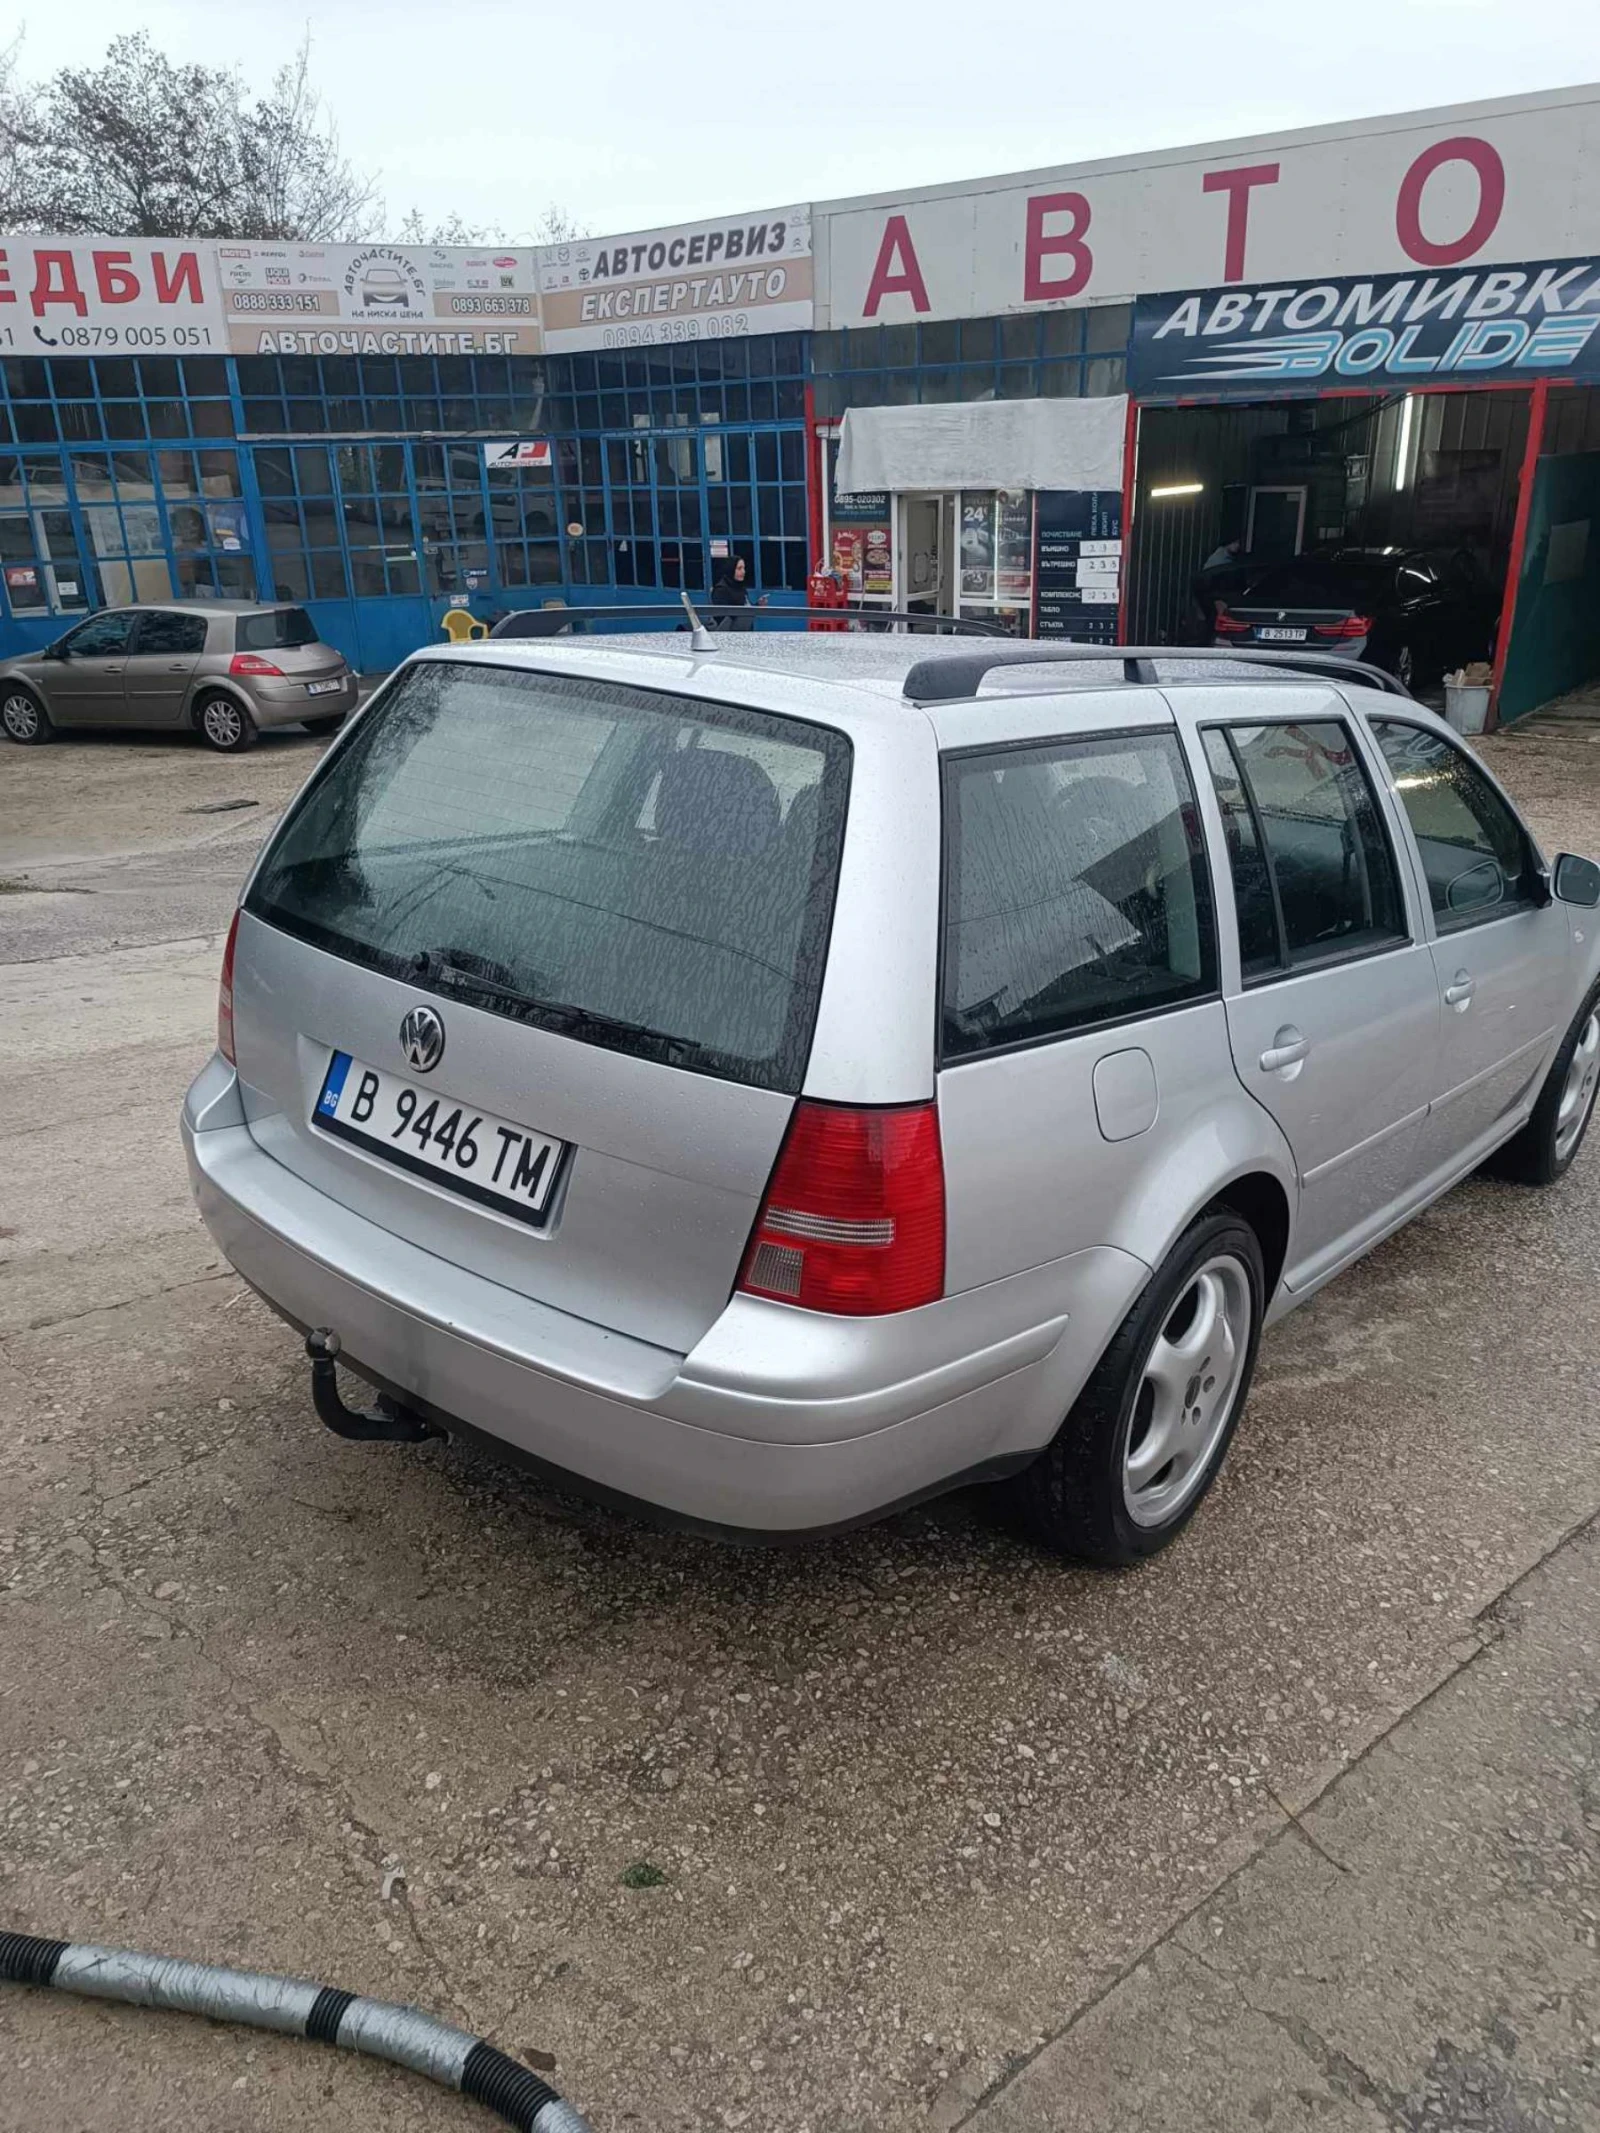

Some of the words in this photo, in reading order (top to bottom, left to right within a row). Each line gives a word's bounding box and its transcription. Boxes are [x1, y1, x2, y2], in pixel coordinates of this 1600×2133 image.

[592, 222, 786, 280] АВТОСЕРВИЗ
[344, 248, 426, 297] АВТОЧАСТИТЕ.БГ
[233, 293, 267, 311] 0888
[268, 293, 294, 311] 333
[296, 294, 320, 311] 151
[451, 297, 481, 314] 0893
[483, 298, 507, 314] 663
[508, 298, 530, 314] 378
[580, 267, 786, 322] ЕКСПЕРТАУТО
[367, 310, 397, 318] НИСКА
[400, 310, 424, 318] ЦЕНА
[0, 327, 14, 346] 1
[61, 327, 118, 346] 0879
[125, 327, 166, 346] 005
[173, 328, 211, 346] 051
[602, 324, 656, 348] 0894
[660, 319, 700, 343] 339
[707, 313, 749, 339] 082
[257, 331, 519, 354] АВТОЧАСТИТЕ.БГ
[1215, 313, 1600, 380] BOLIDE
[323, 1090, 339, 1107] BG
[350, 1070, 379, 1122] B
[391, 1089, 483, 1168] 9446
[491, 1126, 551, 1199] TM
